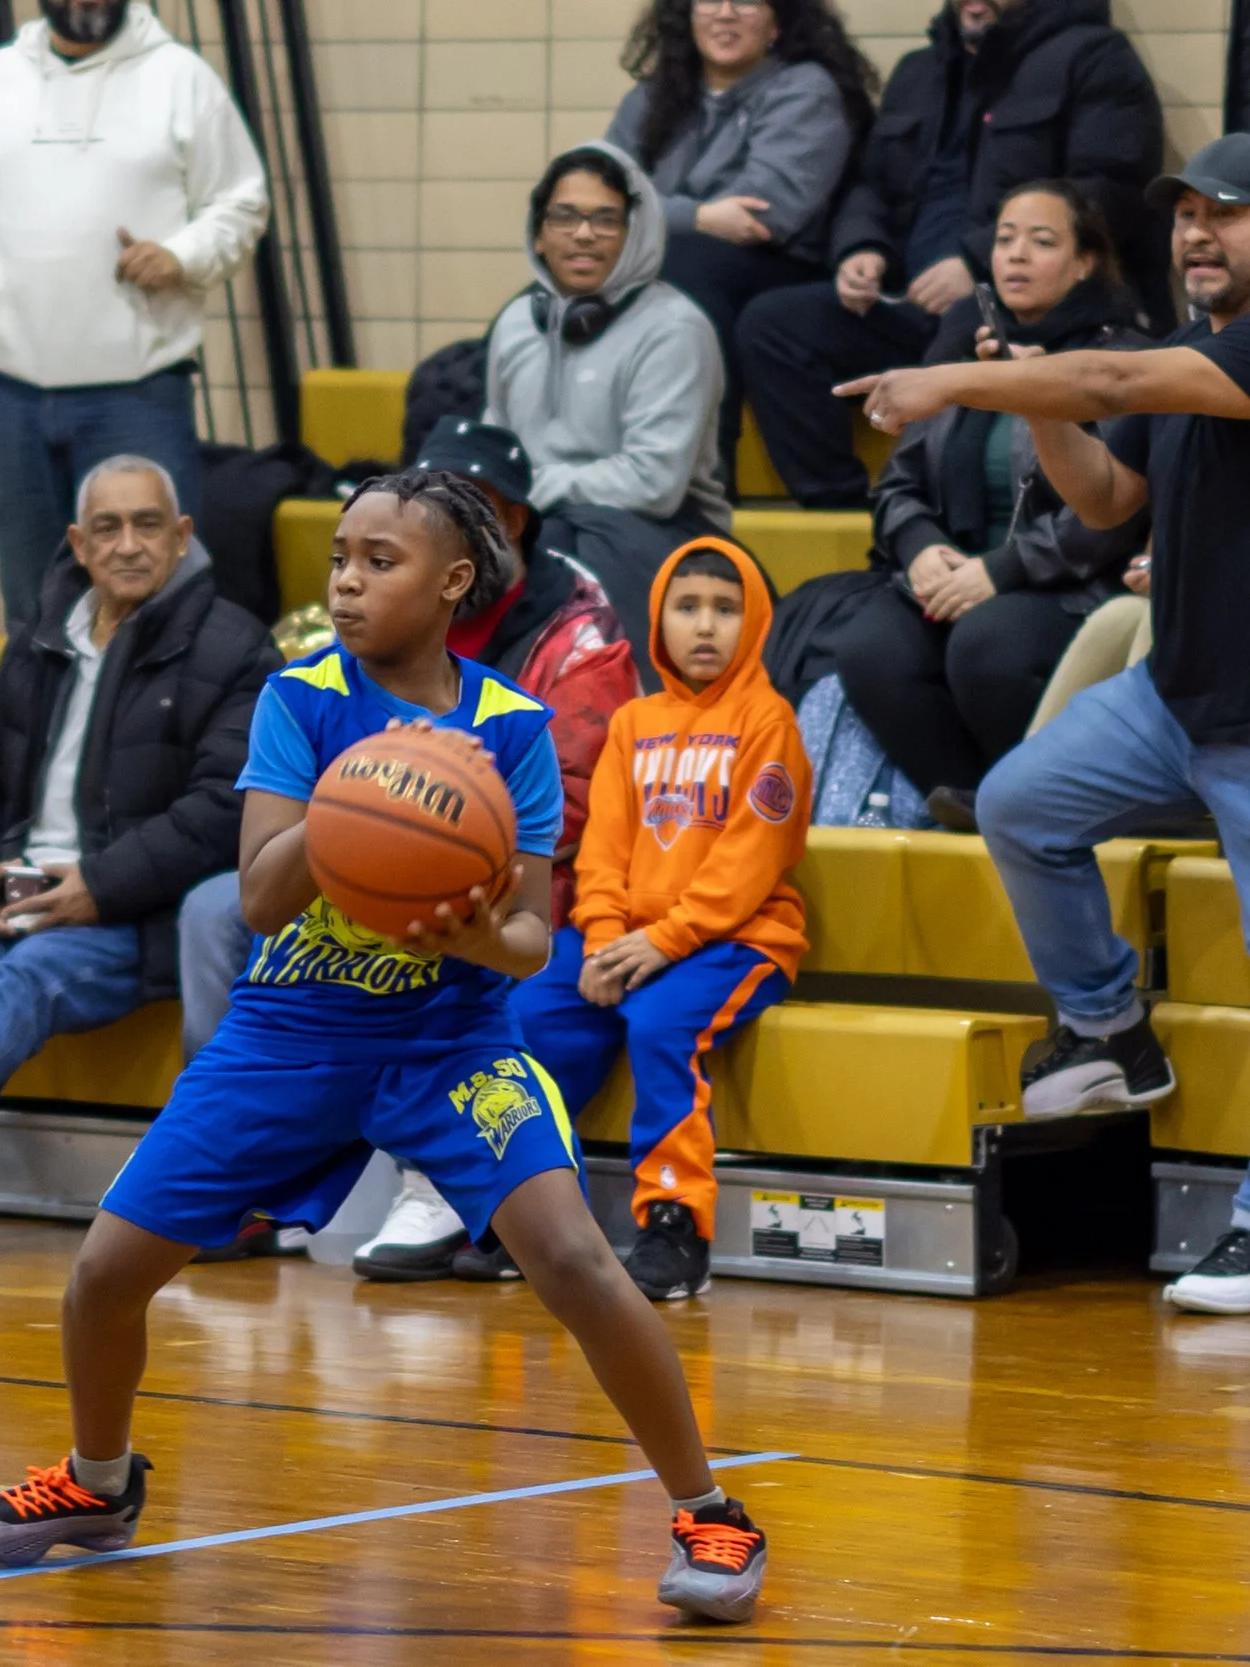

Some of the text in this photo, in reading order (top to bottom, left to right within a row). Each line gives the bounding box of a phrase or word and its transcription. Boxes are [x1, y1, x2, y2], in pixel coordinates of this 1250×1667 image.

[688, 733, 740, 749] YORK
[337, 756, 467, 829] Wilson
[250, 926, 443, 994] WARRIORS
[483, 1098, 543, 1160] WARRIORS
